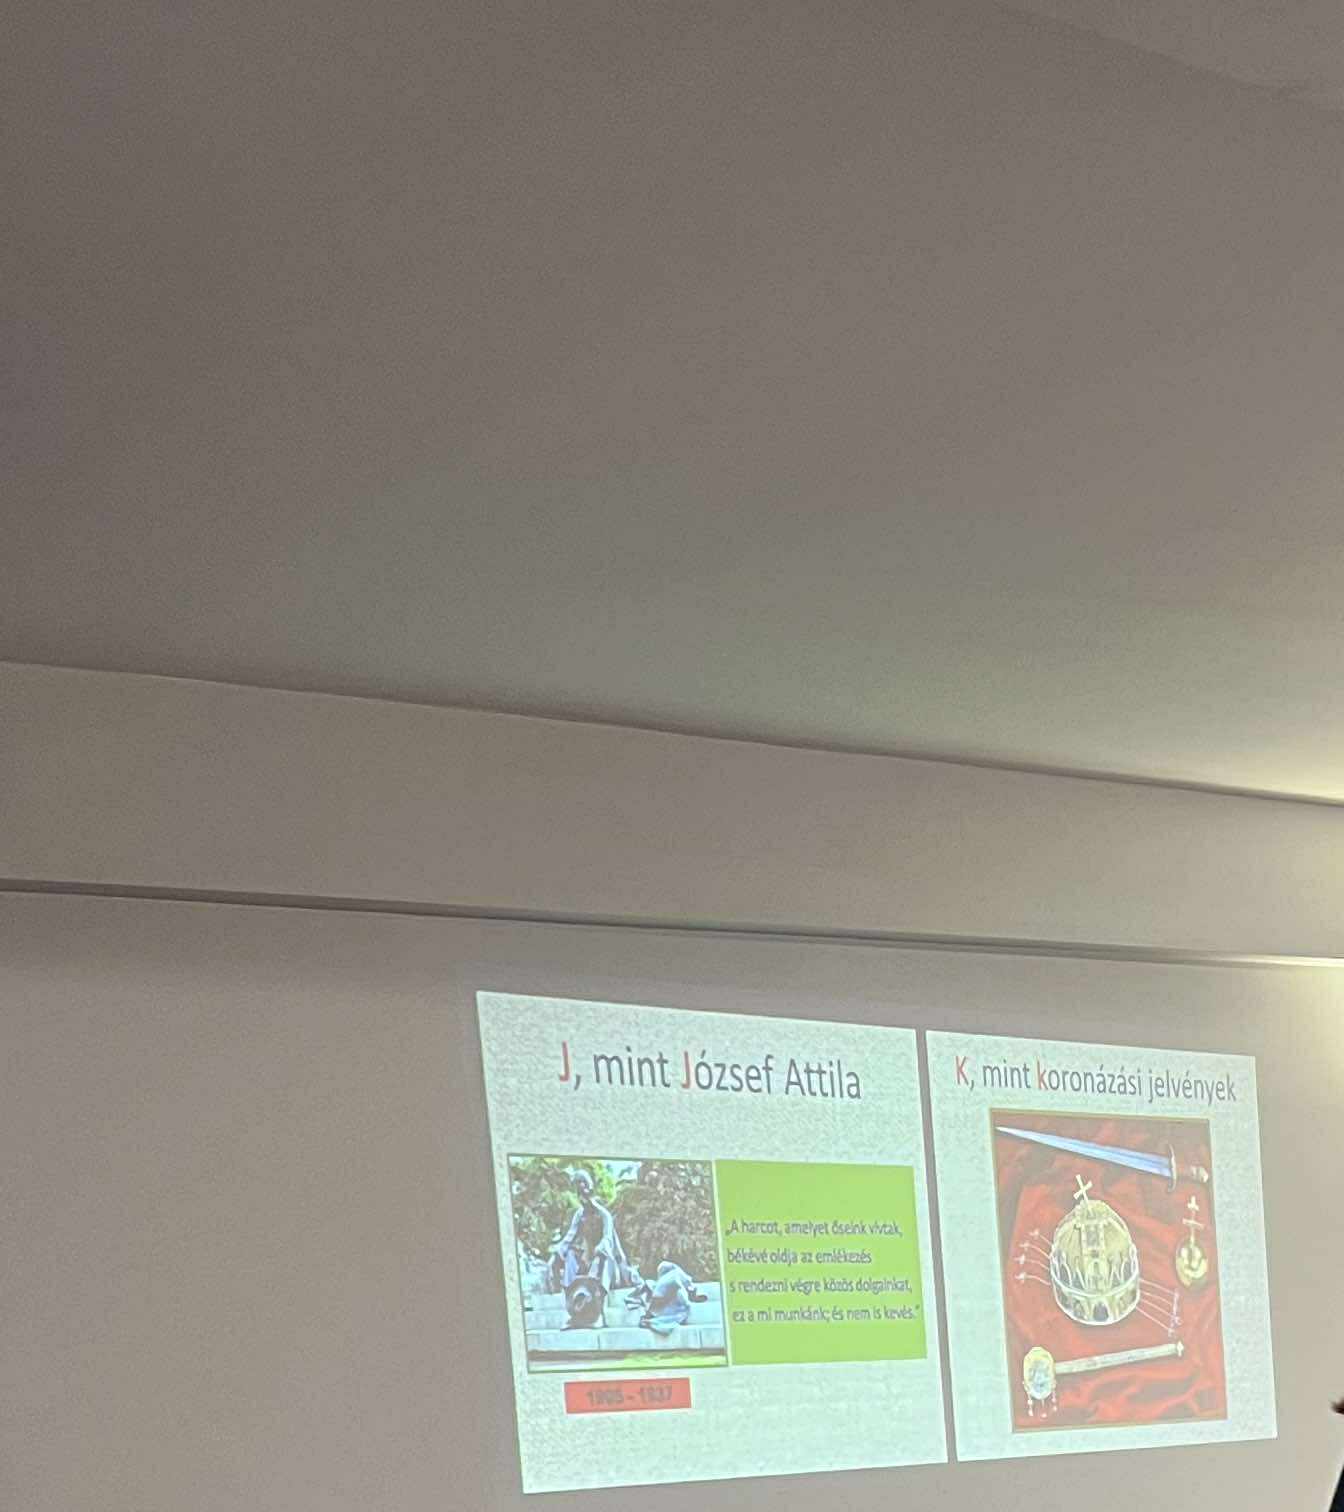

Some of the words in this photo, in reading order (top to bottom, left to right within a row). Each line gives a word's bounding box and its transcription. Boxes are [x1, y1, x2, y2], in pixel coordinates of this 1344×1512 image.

[559, 1040, 581, 1091] J,
[593, 1046, 671, 1088] mint
[681, 1049, 774, 1095] József
[784, 1057, 862, 1100] Attila
[955, 1055, 975, 1091] K,
[982, 1059, 1031, 1089] mint
[1036, 1061, 1142, 1097] koronázási
[1148, 1069, 1237, 1106] jelvények
[741, 1219, 783, 1237] harcot,
[785, 1220, 829, 1238] amelyet
[769, 1248, 798, 1267] oldja
[800, 1253, 813, 1264] az
[815, 1248, 872, 1265] emlékezés
[729, 1282, 736, 1293] s
[738, 1278, 788, 1293] rendezni
[790, 1279, 821, 1296] végre
[823, 1277, 854, 1293] közös
[732, 1310, 746, 1323] ez
[748, 1311, 755, 1322] a
[757, 1307, 772, 1321] mi
[831, 1306, 845, 1322] és
[847, 1308, 870, 1321] nem
[872, 1306, 883, 1320] is
